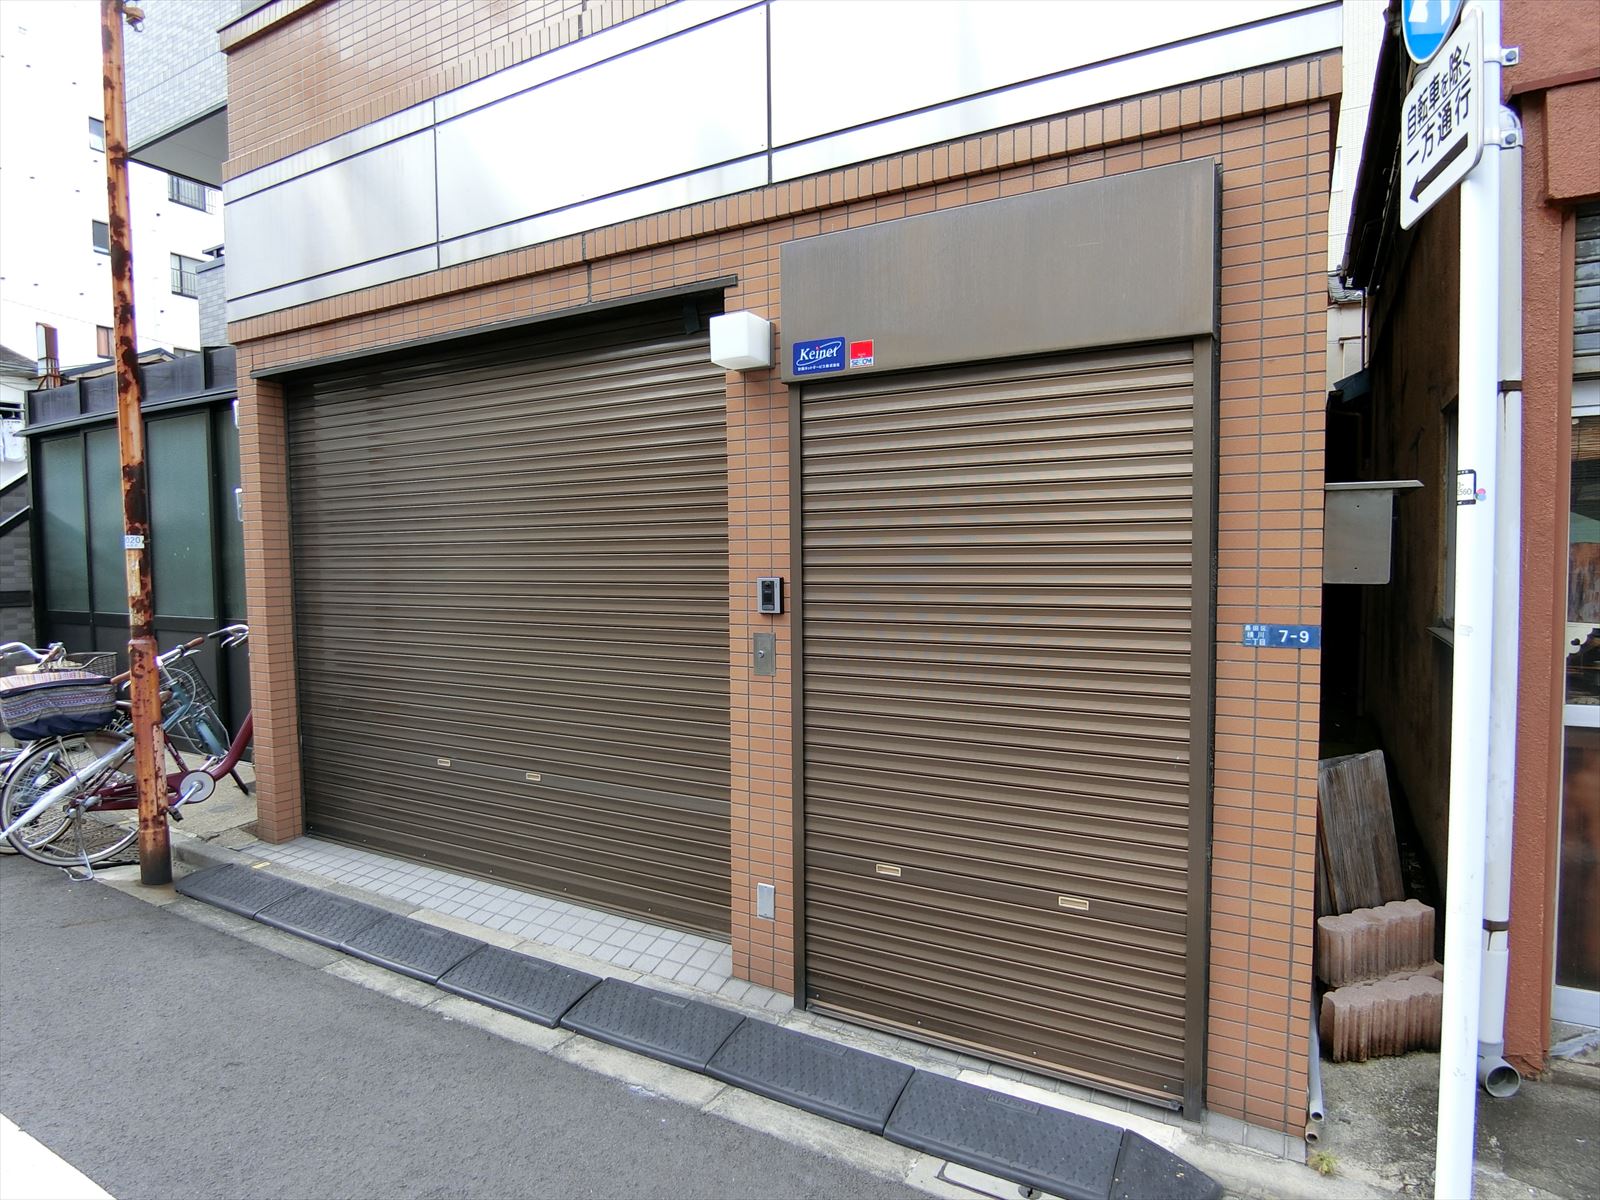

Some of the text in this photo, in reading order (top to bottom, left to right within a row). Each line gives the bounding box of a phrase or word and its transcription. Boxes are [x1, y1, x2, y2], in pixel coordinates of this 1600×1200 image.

[1406, 77, 1471, 165] 一方通行
[1407, 43, 1471, 140] 自転車を除く
[1278, 630, 1310, 643] 7-9
